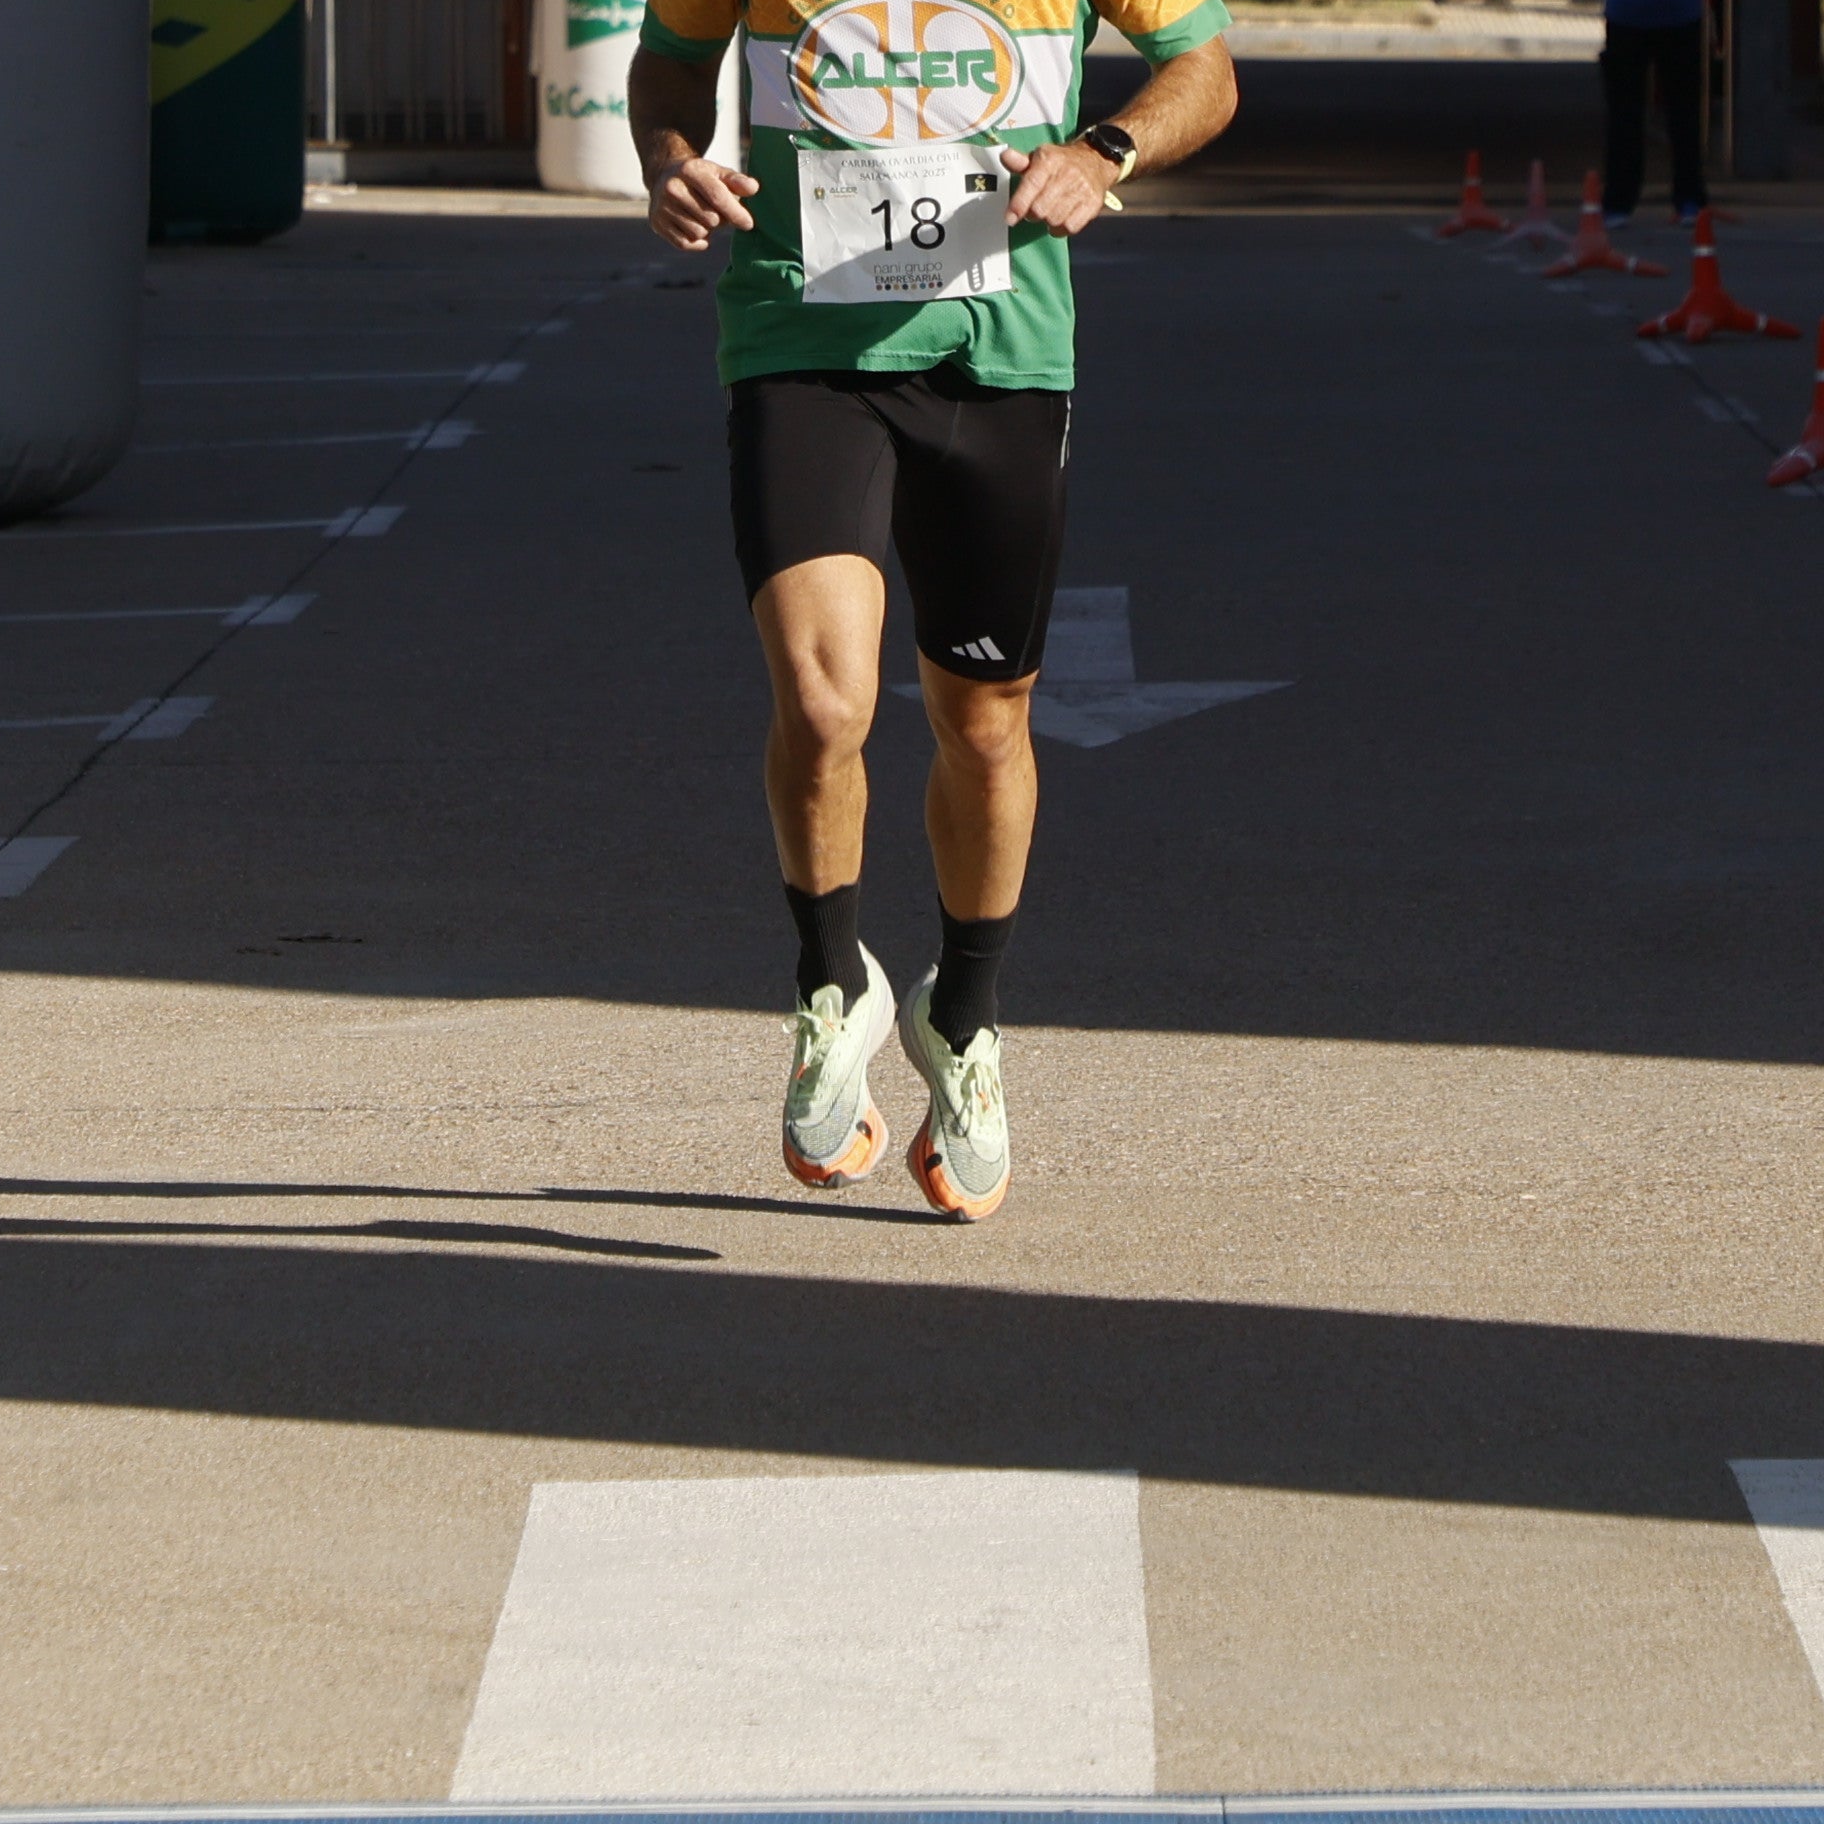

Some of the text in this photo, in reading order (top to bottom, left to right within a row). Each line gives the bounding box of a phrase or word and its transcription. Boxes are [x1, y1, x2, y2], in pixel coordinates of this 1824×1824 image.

[811, 49, 1000, 94] ALCER
[871, 197, 945, 251] 18
[874, 261, 943, 276] nani grupo
[875, 274, 943, 285] EMPRESARIAL
